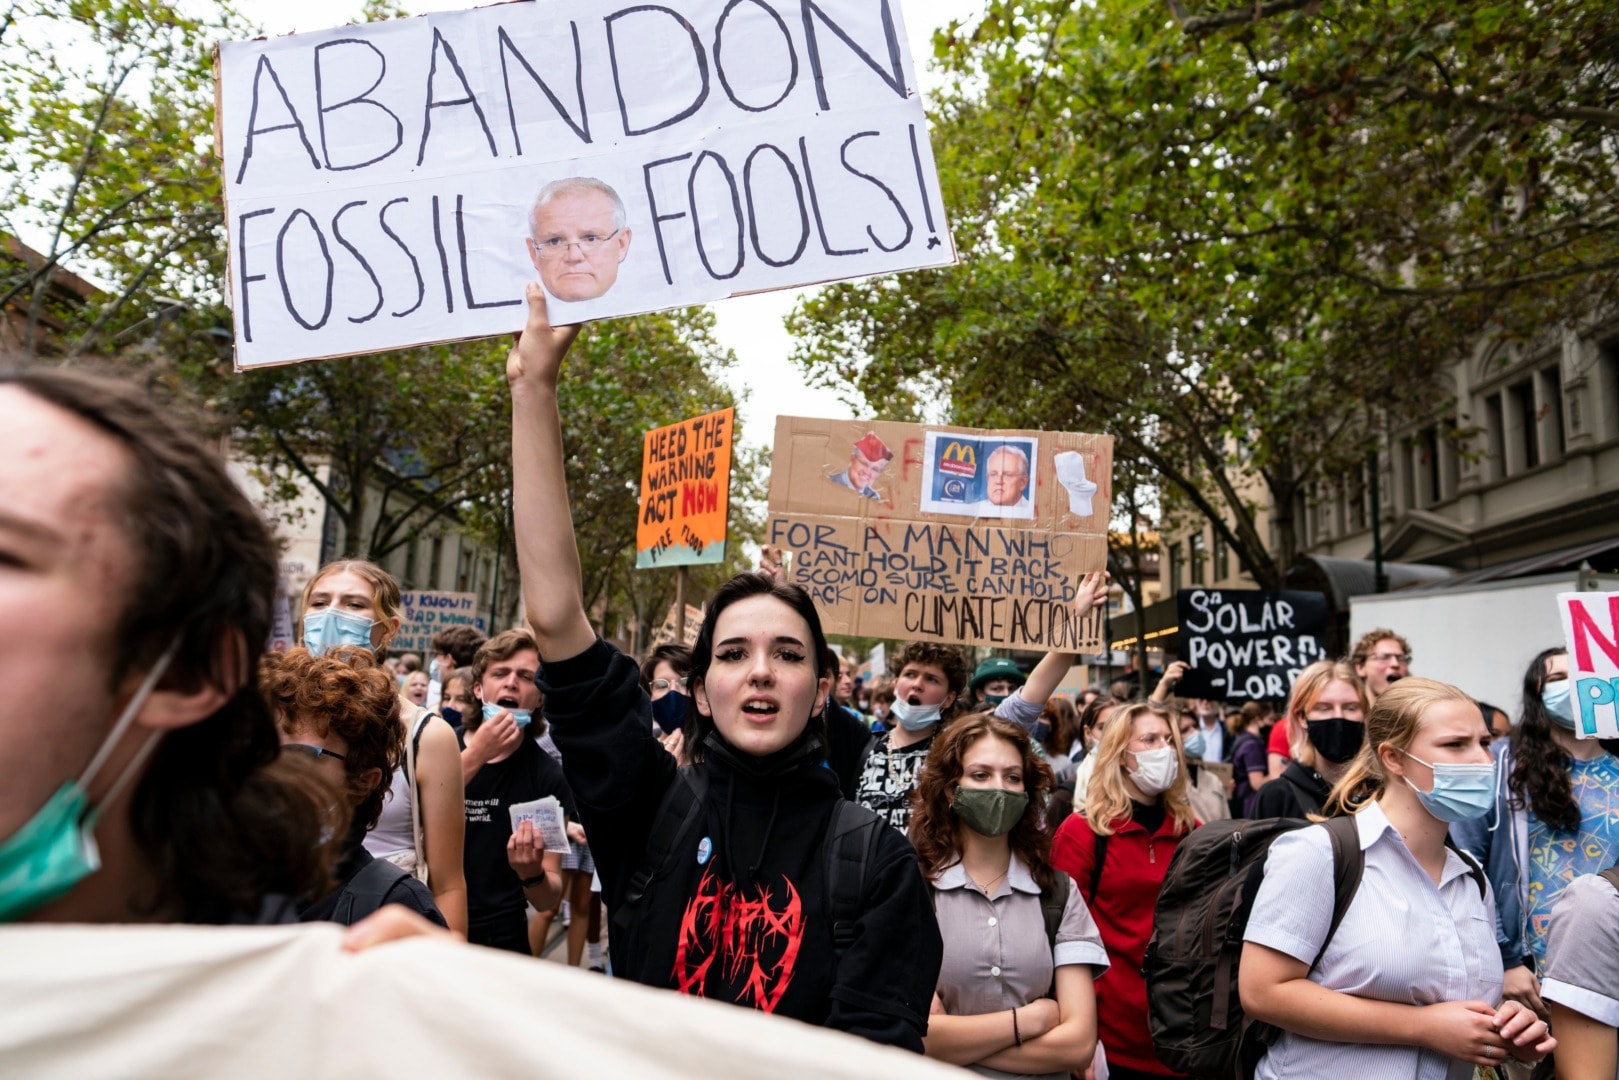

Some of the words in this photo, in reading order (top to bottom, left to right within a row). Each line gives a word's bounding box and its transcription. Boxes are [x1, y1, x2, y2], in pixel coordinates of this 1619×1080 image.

[237, 0, 911, 184] ABANDON
[239, 194, 521, 342] FOSSIL
[645, 124, 942, 285] FOOLS!
[650, 426, 687, 463] HEED
[692, 415, 725, 451] THE
[647, 452, 715, 492] WARNING
[643, 489, 677, 525] ACT
[682, 480, 718, 517] NOW
[651, 528, 673, 563] FIRE
[681, 524, 704, 557] FLOOD
[771, 519, 848, 550] FOR
[864, 526, 891, 552] A
[903, 524, 990, 559] MAN
[997, 529, 1073, 559] WHO
[797, 550, 860, 569] CANT
[868, 551, 948, 574] HOLD
[956, 557, 983, 576] IT
[990, 557, 1069, 586] BACK,
[885, 572, 959, 594] SURE
[966, 576, 1015, 595] CAN
[1020, 577, 1076, 603] HOLD
[406, 608, 436, 622] BAD
[419, 594, 459, 608] KNOW
[864, 587, 898, 605] ON
[905, 592, 1006, 642] CLIMATE
[1186, 590, 1295, 635] SOLAR
[1189, 635, 1296, 669] POWER
[464, 799, 484, 807] men
